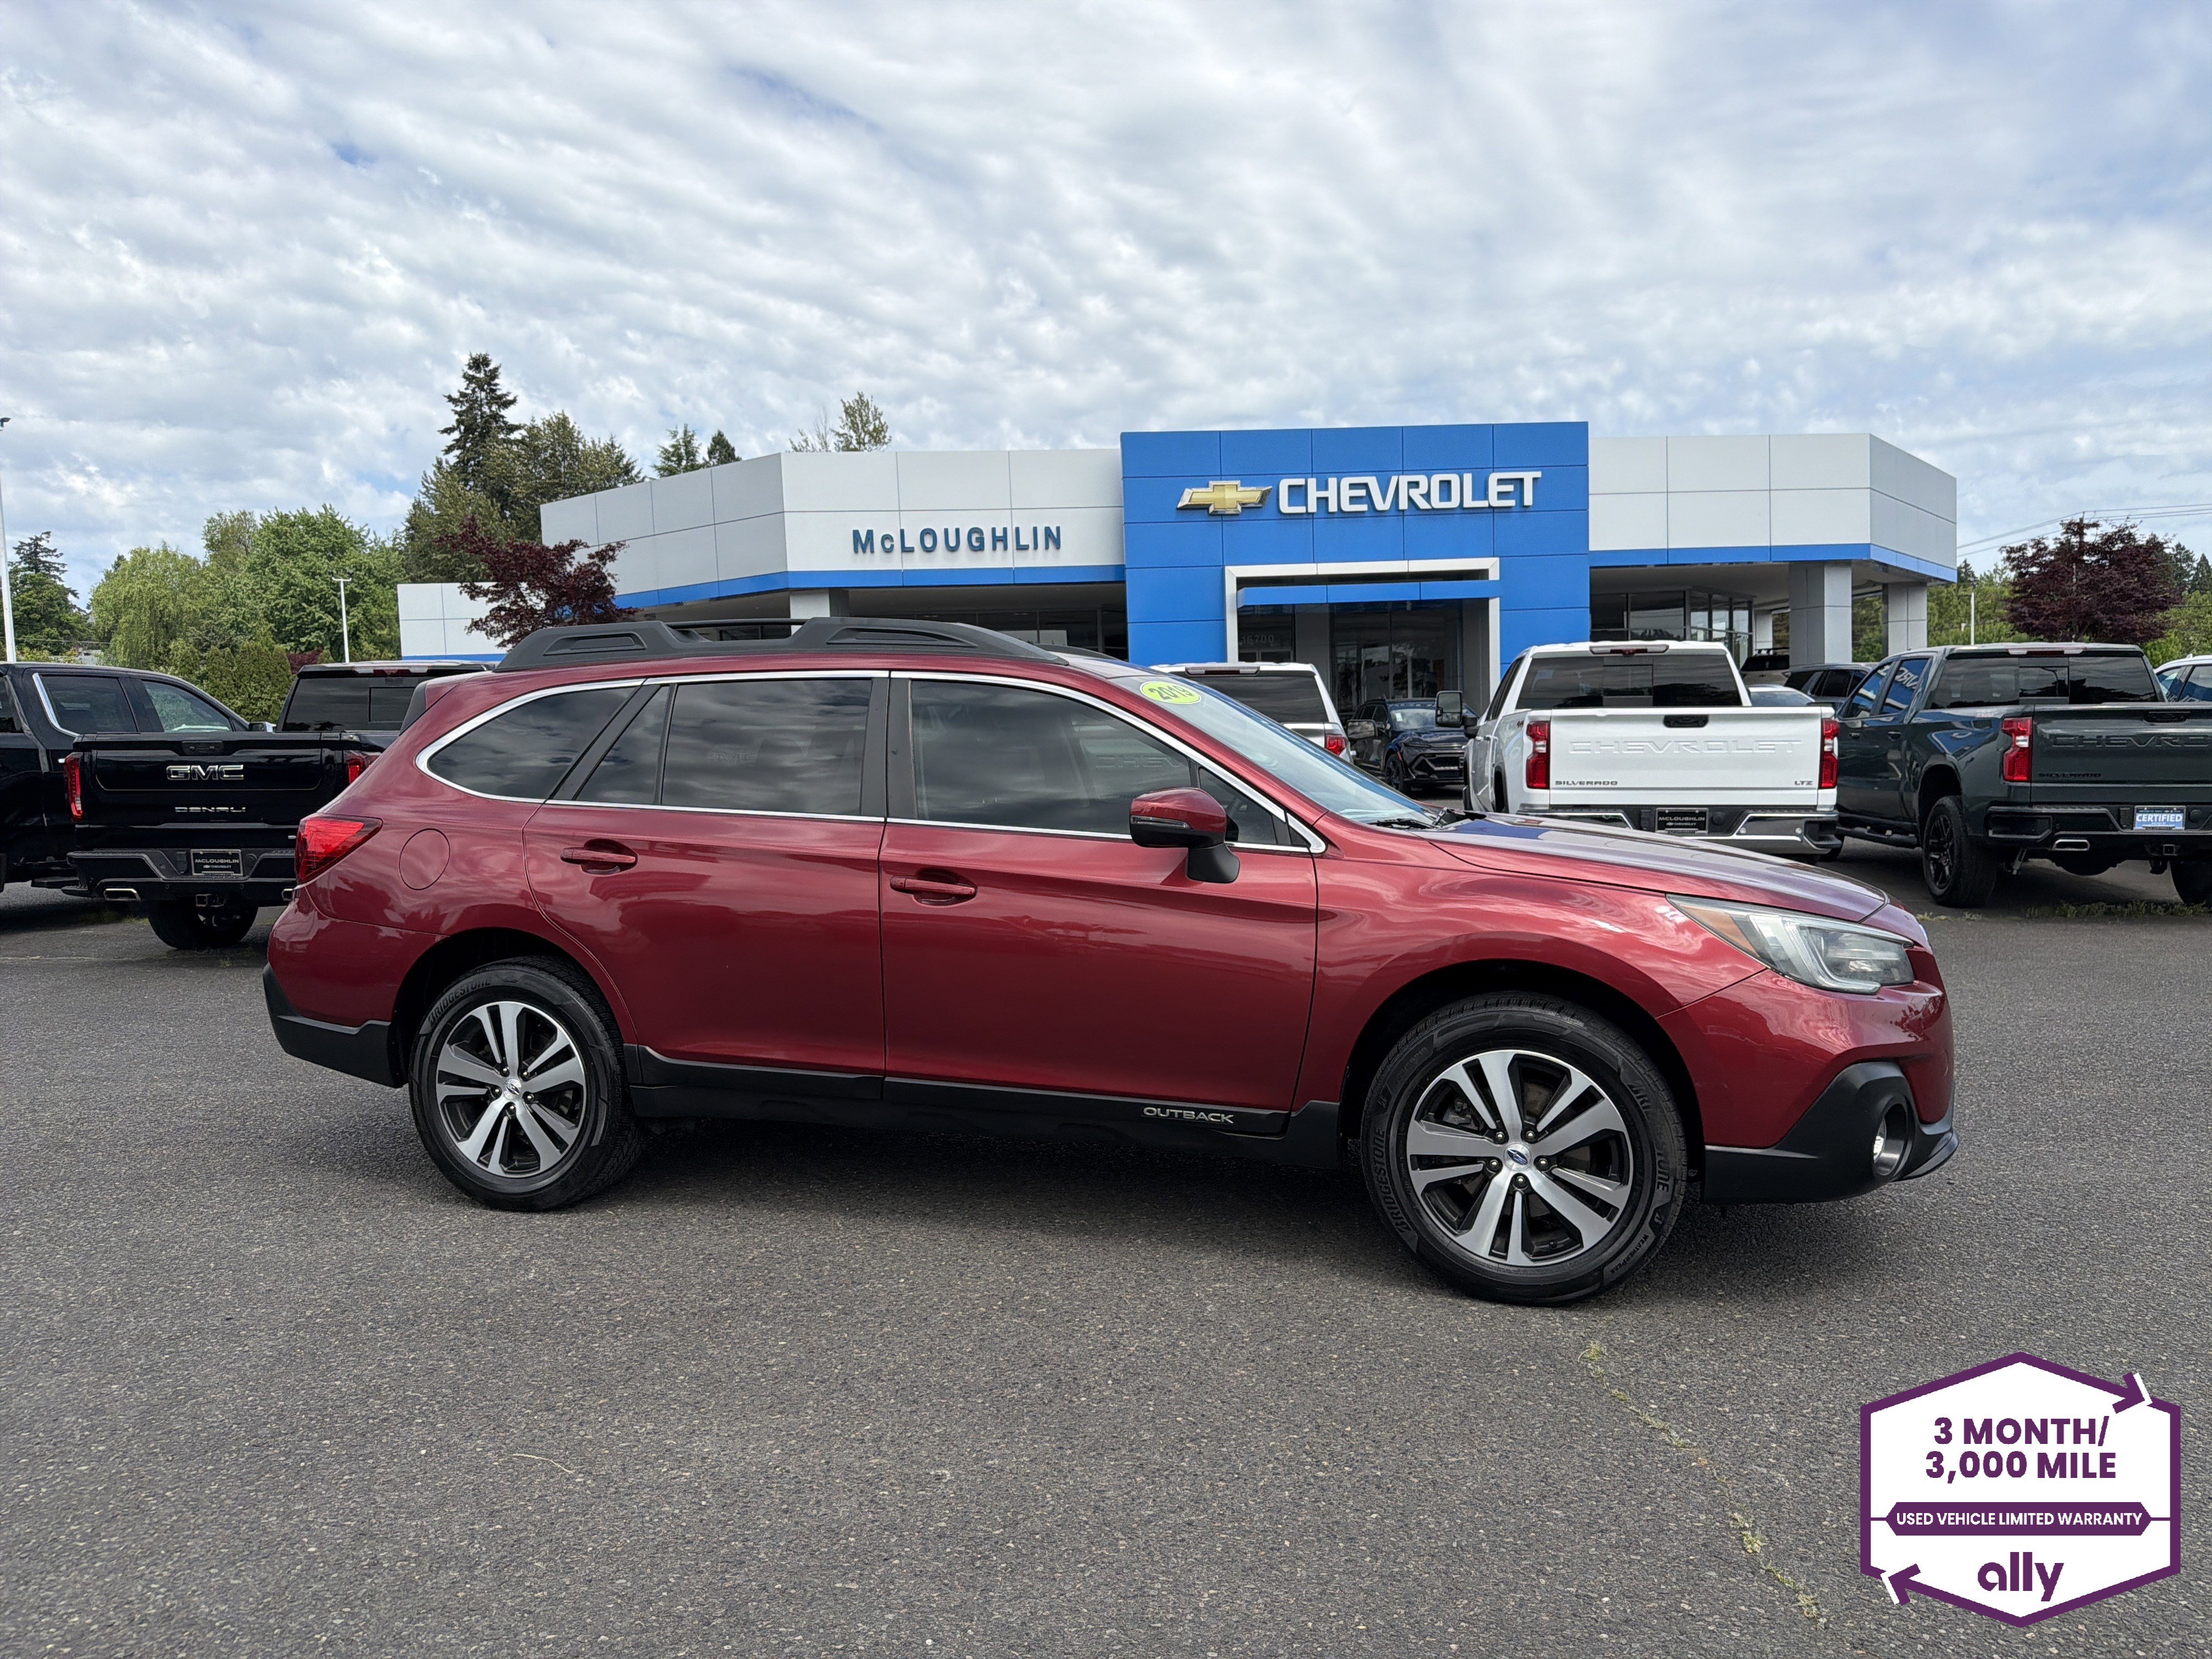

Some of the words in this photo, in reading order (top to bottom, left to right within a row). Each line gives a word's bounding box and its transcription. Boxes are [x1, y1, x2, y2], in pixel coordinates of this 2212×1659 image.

[1279, 471, 1542, 514] CHEVROLET
[1148, 685, 1195, 700] 2019
[1568, 740, 1802, 754] CHEVROLET
[166, 764, 244, 781] GMC
[2136, 813, 2183, 822] CERTIFIED
[1143, 1107, 1234, 1124] OUTBACK
[1373, 1128, 1412, 1233] BRIDGESTONE
